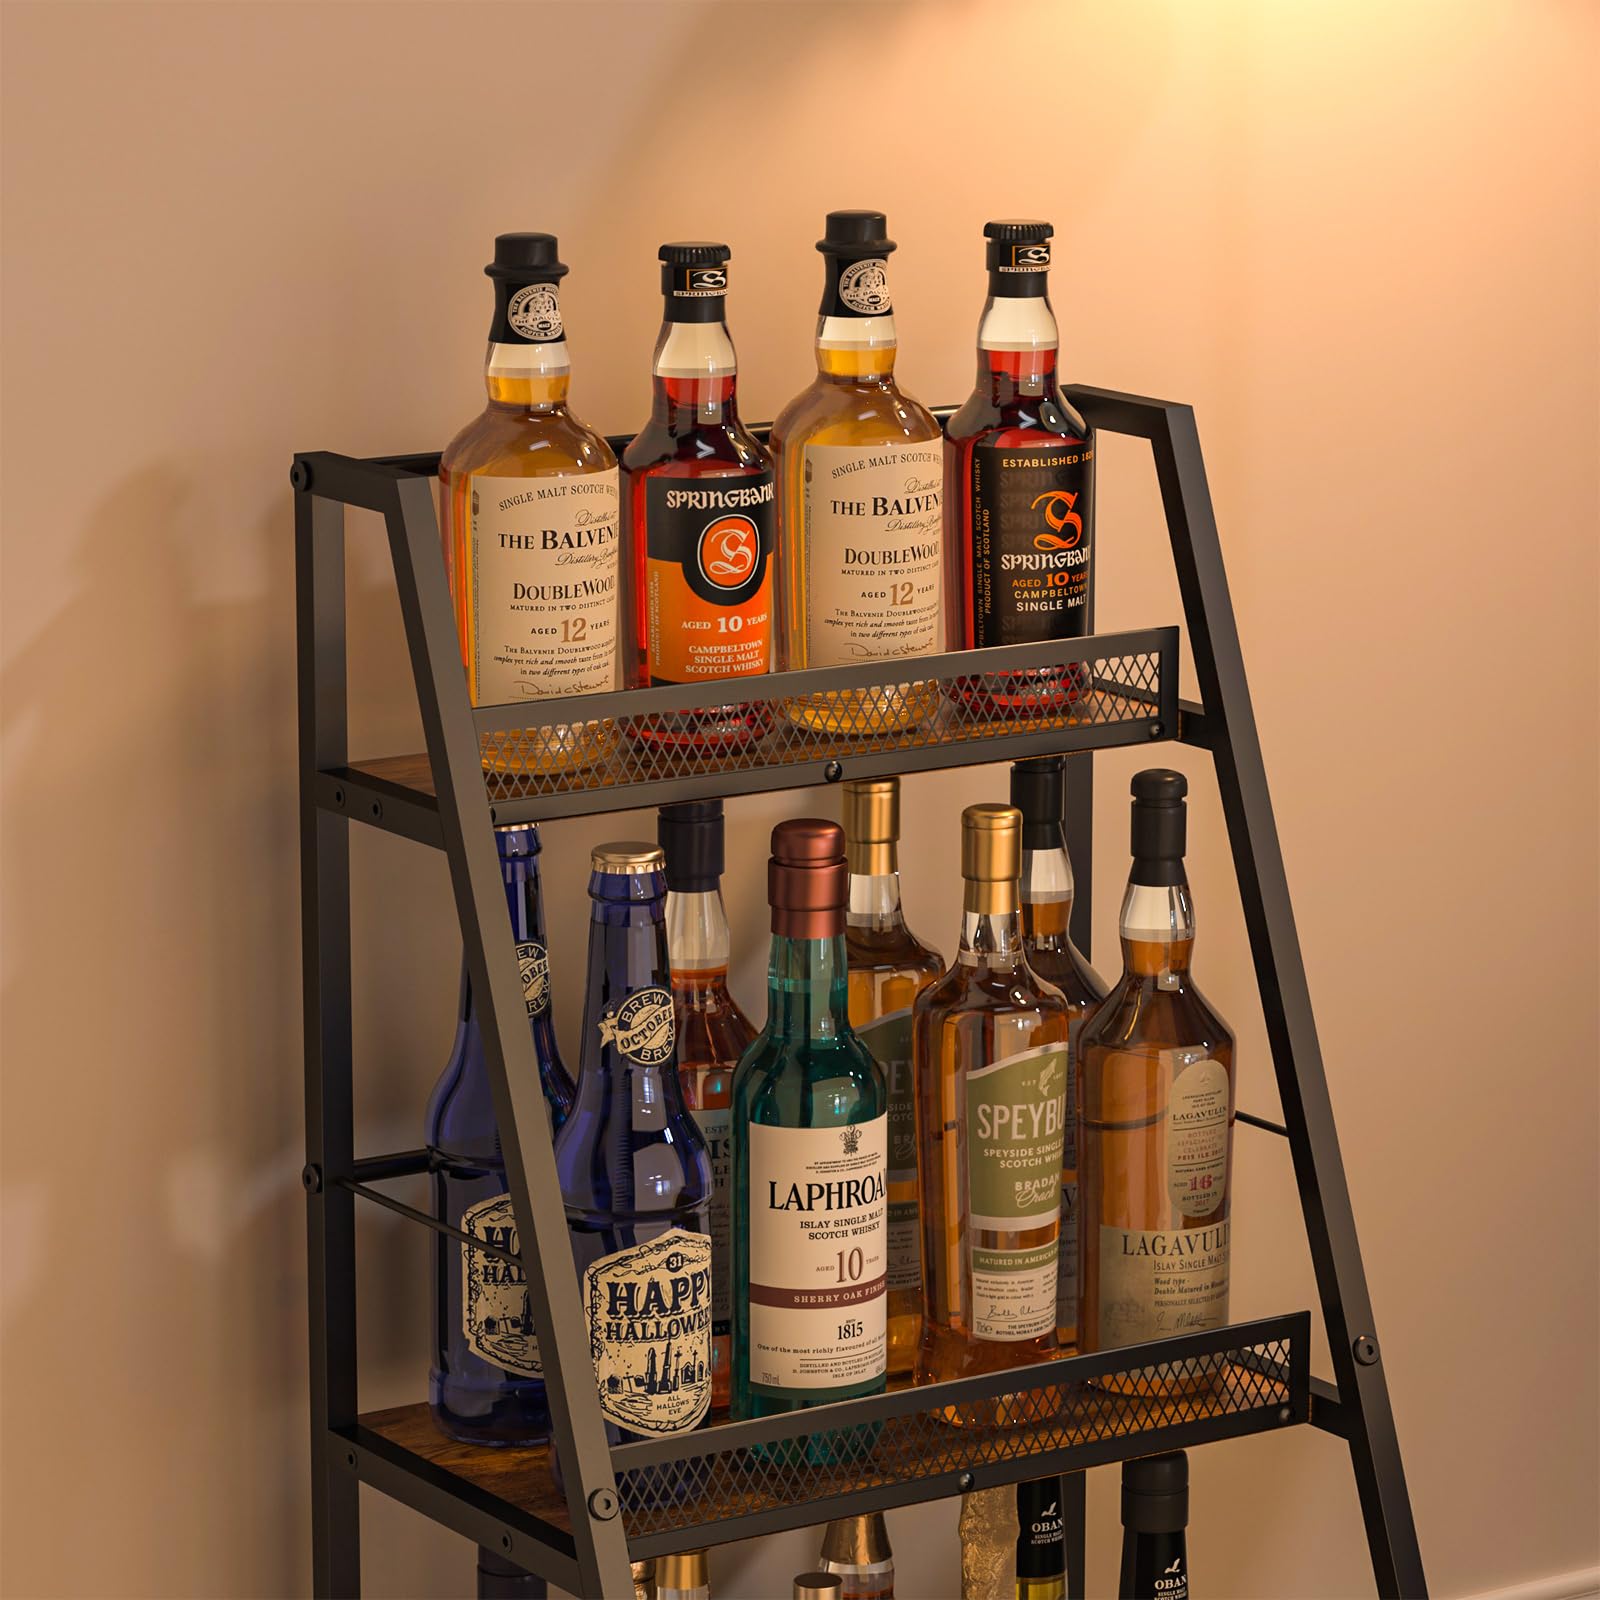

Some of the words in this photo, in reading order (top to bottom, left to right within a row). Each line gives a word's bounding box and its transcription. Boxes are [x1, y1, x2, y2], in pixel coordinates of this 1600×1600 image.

[832, 460, 866, 479] SINGLE
[869, 455, 898, 468] MALT
[901, 453, 932, 464] SCOTCH
[1002, 455, 1079, 468] ESTABLISHED
[499, 491, 534, 511] SINGLE
[538, 486, 567, 500] MALT
[571, 484, 604, 495] SCOTCH
[666, 481, 774, 510] SPRINGBANK
[830, 500, 866, 516] THE
[1031, 490, 1083, 551] S
[498, 533, 535, 549] THE
[982, 508, 990, 558] SCOTLAND
[709, 529, 753, 575] S
[841, 568, 875, 576] MATURED
[889, 568, 905, 576] TWO
[983, 561, 991, 571] OF
[1012, 578, 1042, 588] AGED
[1046, 571, 1070, 587] 10
[861, 591, 887, 599] AGED
[889, 581, 914, 607] 12
[917, 584, 935, 594] YEARS
[983, 573, 992, 614] PRODUCT
[510, 604, 545, 612] MATURED
[560, 604, 577, 612] TWO
[579, 598, 606, 610] DISTINCT
[1016, 599, 1064, 612] SINGLE
[1067, 593, 1087, 609] MALT
[850, 609, 883, 618] BALVENIE
[531, 627, 558, 635] AGED
[560, 617, 587, 643] 12
[590, 619, 610, 630] YEARS
[681, 620, 711, 630] AGED
[717, 615, 743, 633] 10
[747, 613, 768, 626] YEARS
[855, 620, 868, 628] rich
[870, 620, 882, 628] and
[872, 629, 898, 640] different
[504, 645, 518, 654] THE
[520, 646, 554, 655] BALVENIE
[689, 639, 763, 654] CAMPBELTOWN
[525, 657, 539, 666] rich
[540, 657, 554, 666] and
[555, 656, 577, 666] smooth
[694, 653, 735, 664] SINGLE
[736, 649, 760, 663] MALT
[520, 667, 527, 675] in
[543, 666, 570, 678] different
[686, 663, 730, 674] SCOTCH
[732, 658, 765, 674] WHISKY
[622, 992, 665, 1023] BREW
[640, 1026, 674, 1061] BREW
[1172, 1106, 1227, 1121] LAGAVULIN
[983, 1148, 1034, 1158] SPEYSIDE
[1036, 1139, 1062, 1155] SINGLE
[1000, 1158, 1042, 1169] SCOTCH
[1015, 1172, 1060, 1192] BRADAN
[1189, 1174, 1213, 1191] 16
[800, 1220, 831, 1230] ISLAY
[834, 1214, 867, 1228] SINGLE
[809, 1229, 849, 1241] SCOTCH
[851, 1220, 880, 1237] WHISKY
[669, 1255, 682, 1268] 31
[836, 1246, 864, 1283] 10
[980, 1256, 1013, 1266] MATURED
[1153, 1259, 1177, 1271] ISLAY
[1179, 1258, 1206, 1271] SINGLE
[607, 1269, 711, 1318] HAPPY
[794, 1293, 840, 1304] SHERRY
[843, 1290, 863, 1301] OAK
[837, 1321, 864, 1341] 1815
[757, 1343, 770, 1352] One
[813, 1345, 833, 1355] richly
[836, 1342, 866, 1353] flavoured
[656, 1400, 690, 1411] HALLOWS
[667, 1394, 681, 1402] ALL
[668, 1407, 682, 1416] EVE
